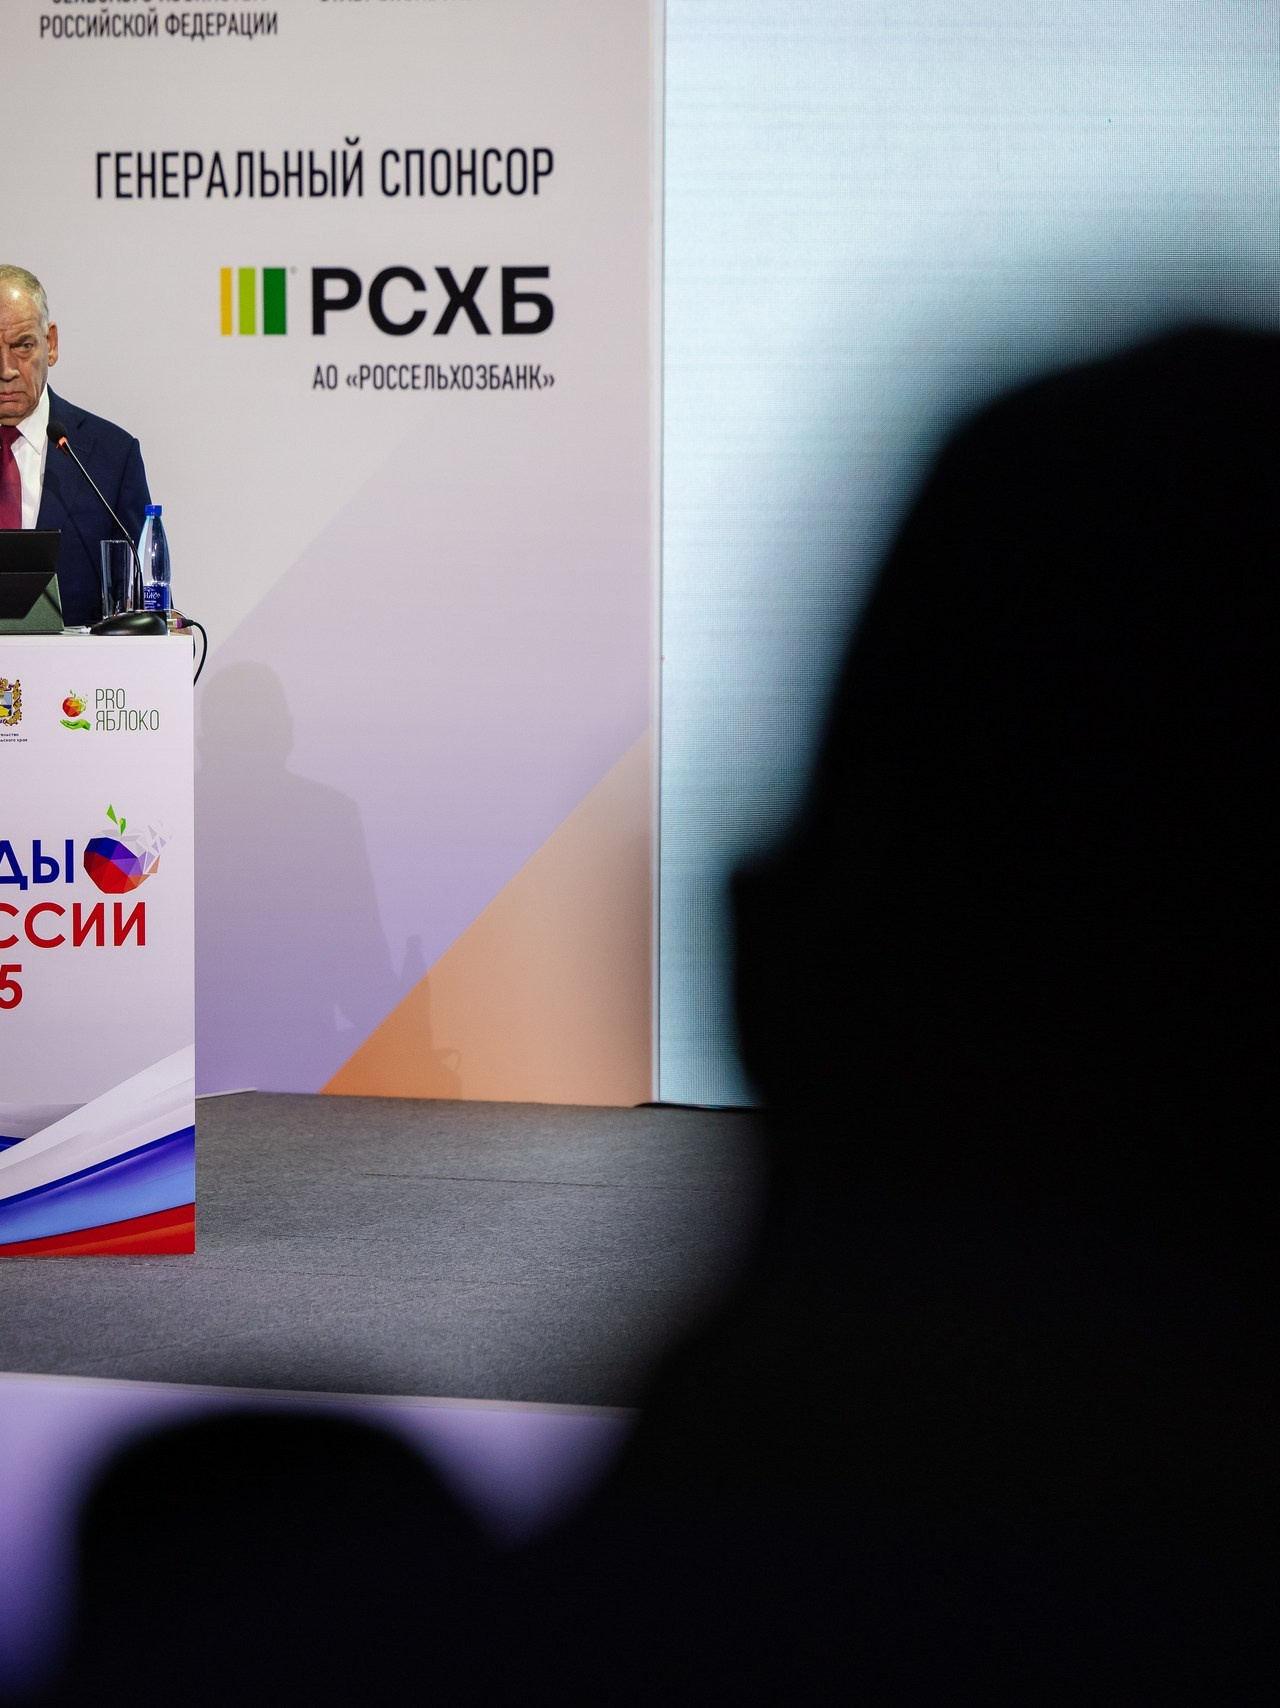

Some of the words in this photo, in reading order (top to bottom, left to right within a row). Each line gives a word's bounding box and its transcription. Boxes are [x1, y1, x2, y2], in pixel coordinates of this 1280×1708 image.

[39, 8, 159, 39] РОССИЙСКОЙ
[165, 12, 278, 41] ФЕДЕРАЦИИ
[95, 136, 364, 200] ГЕНЕРАЛЬНЫЙ
[380, 147, 555, 197] СПОНСОР
[311, 266, 555, 337] РСХБ
[312, 365, 338, 391] АО
[346, 364, 556, 391] «РОССЕЛЬХОЗБАНК»
[95, 688, 126, 710] PRO
[95, 709, 160, 731] ЯБЛОКО
